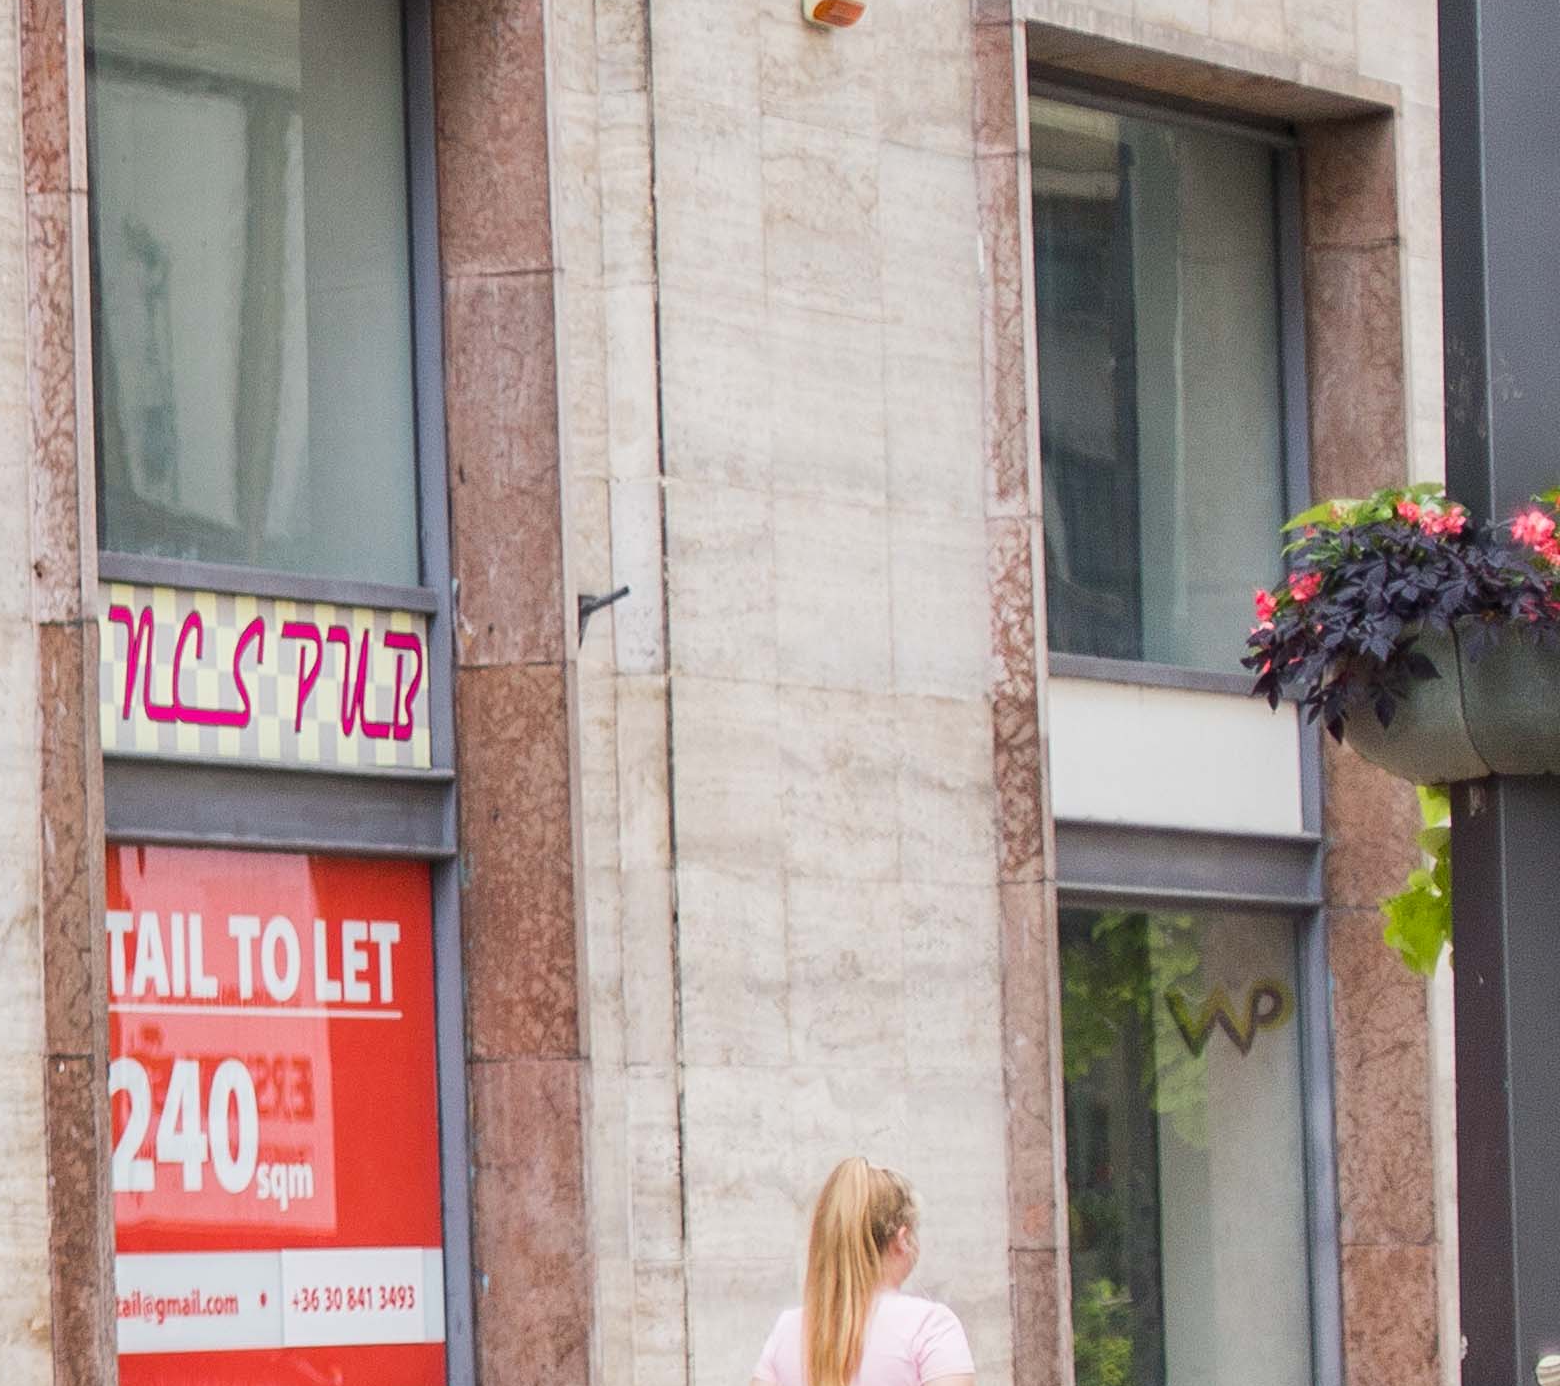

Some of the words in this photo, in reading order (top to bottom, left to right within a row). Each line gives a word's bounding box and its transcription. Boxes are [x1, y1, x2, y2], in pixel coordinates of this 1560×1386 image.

[281, 621, 424, 742] PUB
[229, 914, 301, 1002] TO
[314, 918, 401, 1004] LET
[108, 1057, 259, 1195] 240
[256, 1161, 314, 1212] sqm
[324, 1286, 342, 1311] 30
[346, 1285, 373, 1311] 841
[378, 1284, 416, 1310] 3493
